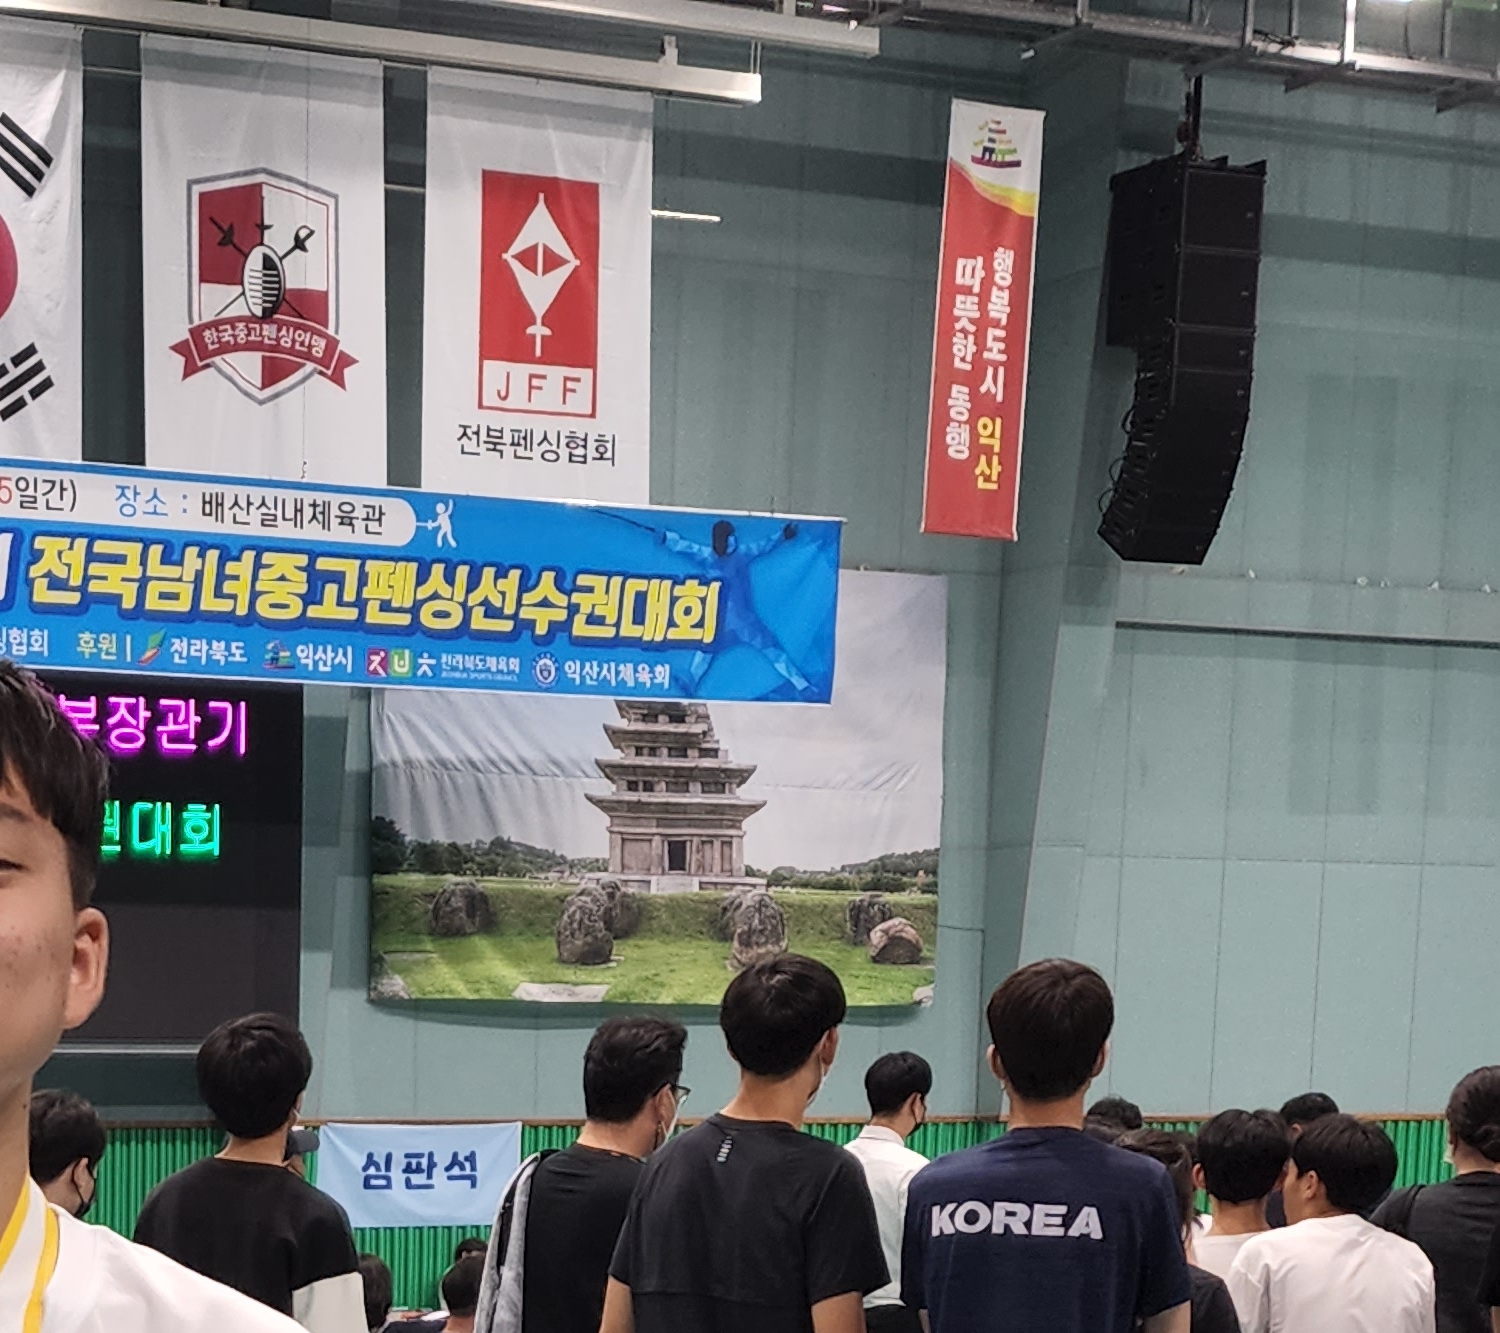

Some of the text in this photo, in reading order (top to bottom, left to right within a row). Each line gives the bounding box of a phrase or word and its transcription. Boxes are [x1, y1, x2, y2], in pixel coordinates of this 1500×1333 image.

[202, 322, 327, 358] 한국중고펜싱연맹
[945, 256, 986, 460] 따뜻한 동행
[974, 247, 1015, 491] 행복도시 익산
[457, 423, 618, 467] 전북펜싱협회
[115, 484, 169, 518] 장소
[201, 491, 386, 536] 배산실내체육관
[29, 534, 722, 643] 전국남녀중고펜싱선수권대회
[77, 631, 117, 662] 후원
[170, 637, 248, 664] 전라북도
[296, 644, 353, 674] 익산시
[564, 660, 670, 689] 익산시체육회
[361, 1151, 478, 1191] 심판석
[931, 1201, 1103, 1240] KOREA
